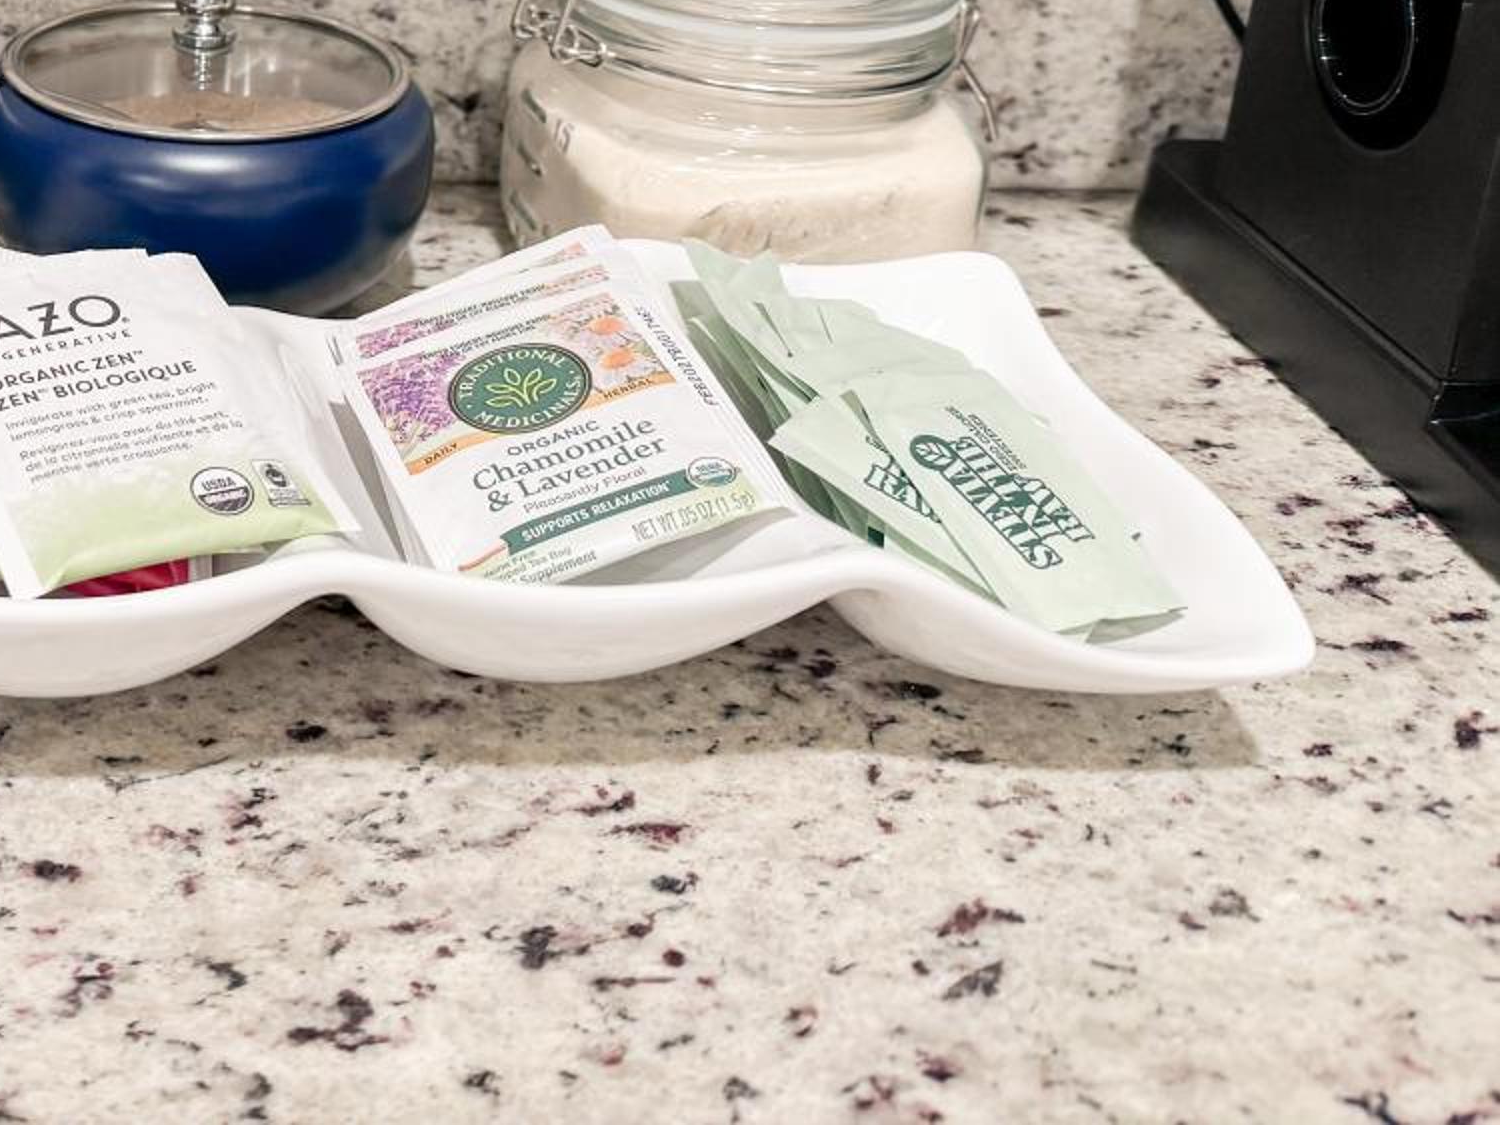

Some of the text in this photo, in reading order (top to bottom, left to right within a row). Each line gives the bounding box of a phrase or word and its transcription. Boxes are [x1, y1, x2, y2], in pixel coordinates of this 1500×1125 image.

[52, 359, 198, 399] BIOLOGIQUE
[458, 348, 567, 399] TRADITIONAL
[5, 409, 74, 432] Invigorate
[77, 401, 107, 416] with
[109, 395, 146, 410] green
[175, 381, 217, 398] bright
[10, 418, 90, 443] lemongrass
[103, 408, 137, 424] crisp
[473, 376, 583, 428] MEDICINALS
[423, 442, 458, 465] DAILY
[472, 419, 657, 491] Chamomile
[506, 419, 601, 457] ORGANIC
[201, 476, 237, 492] USDA
[486, 437, 668, 512] & Lavender
[523, 466, 647, 514] Pleasantly Floral
[948, 437, 1021, 503] THE
[520, 508, 590, 542] SUPPORTS
[631, 518, 659, 543] NET
[696, 499, 718, 520] OZ
[940, 457, 1063, 569] STEVIA
